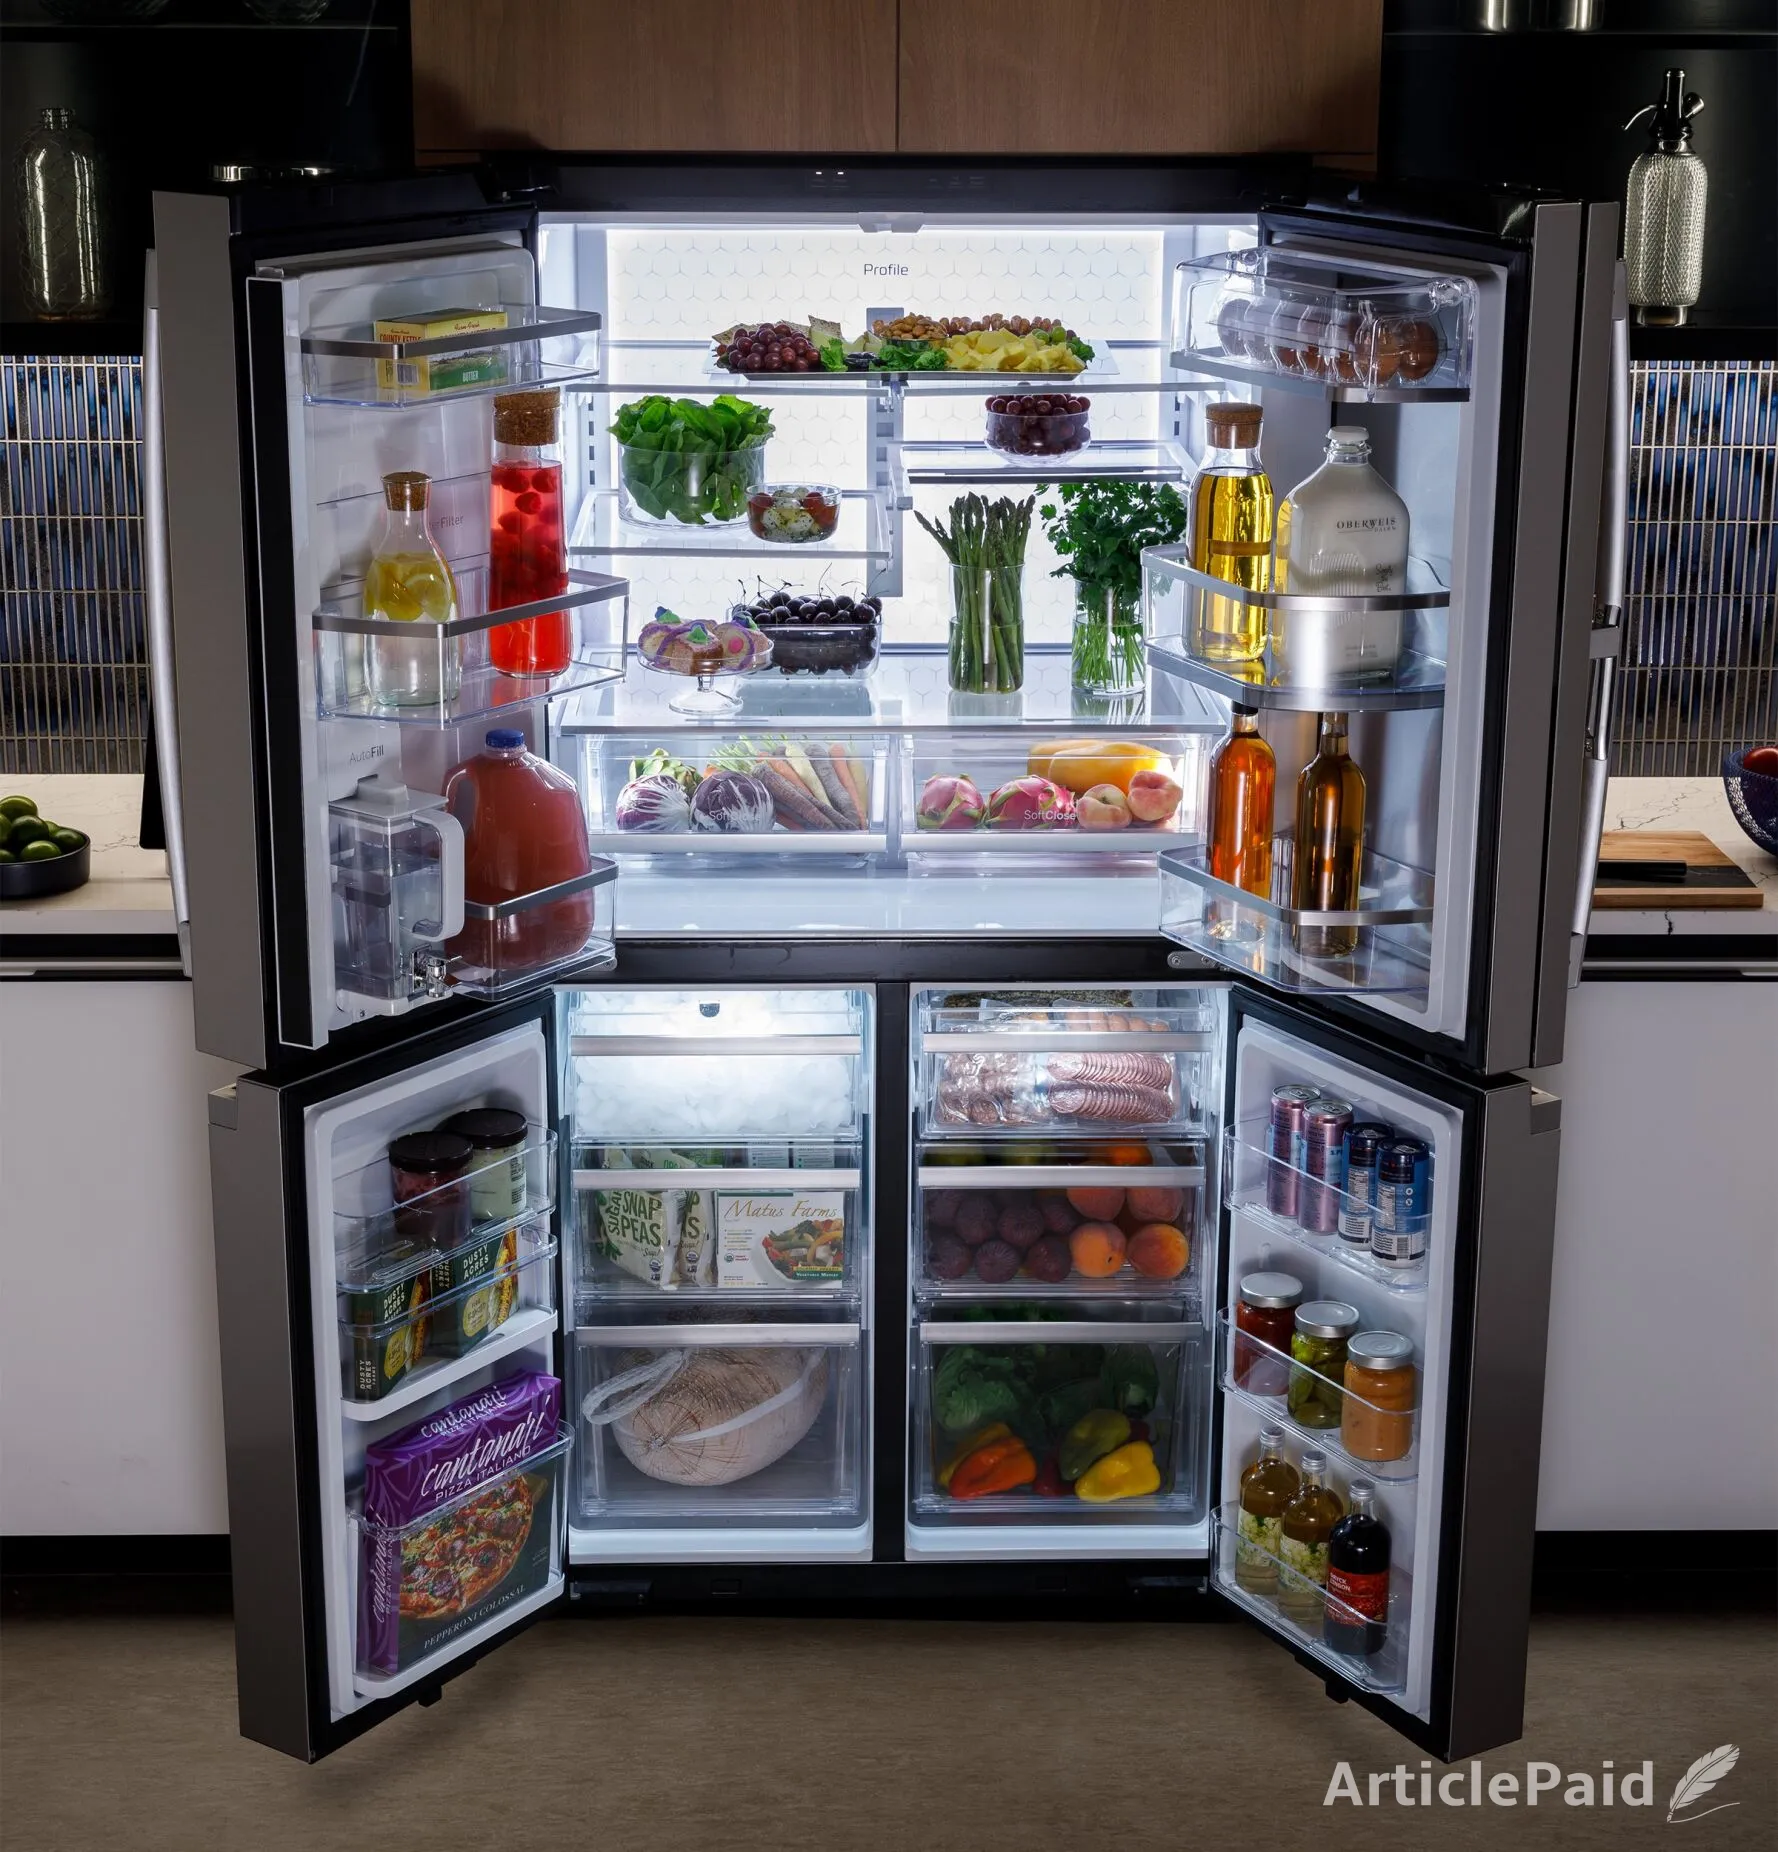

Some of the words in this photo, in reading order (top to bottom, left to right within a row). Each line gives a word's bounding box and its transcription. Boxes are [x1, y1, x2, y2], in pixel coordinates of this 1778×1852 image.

[863, 263, 909, 276] Profile
[1336, 517, 1397, 530] OBERWEIS
[349, 744, 385, 763] AutoFill
[1024, 809, 1077, 821] SoftClose
[622, 1190, 662, 1220] SNAP
[724, 1199, 785, 1219] Matus
[791, 1199, 838, 1218] Farms
[620, 1214, 662, 1248] PEAS
[463, 1243, 489, 1269] DUSTY
[463, 1256, 489, 1280] ACRES
[383, 1282, 405, 1308] DUSTY
[383, 1293, 405, 1320] ACRES
[439, 1419, 469, 1437] PIZZA
[435, 1478, 472, 1503] PIZZA
[476, 1444, 532, 1482] ITALIANO
[423, 1609, 479, 1649] PEPPERONI
[479, 1584, 526, 1616] COLOSSAL
